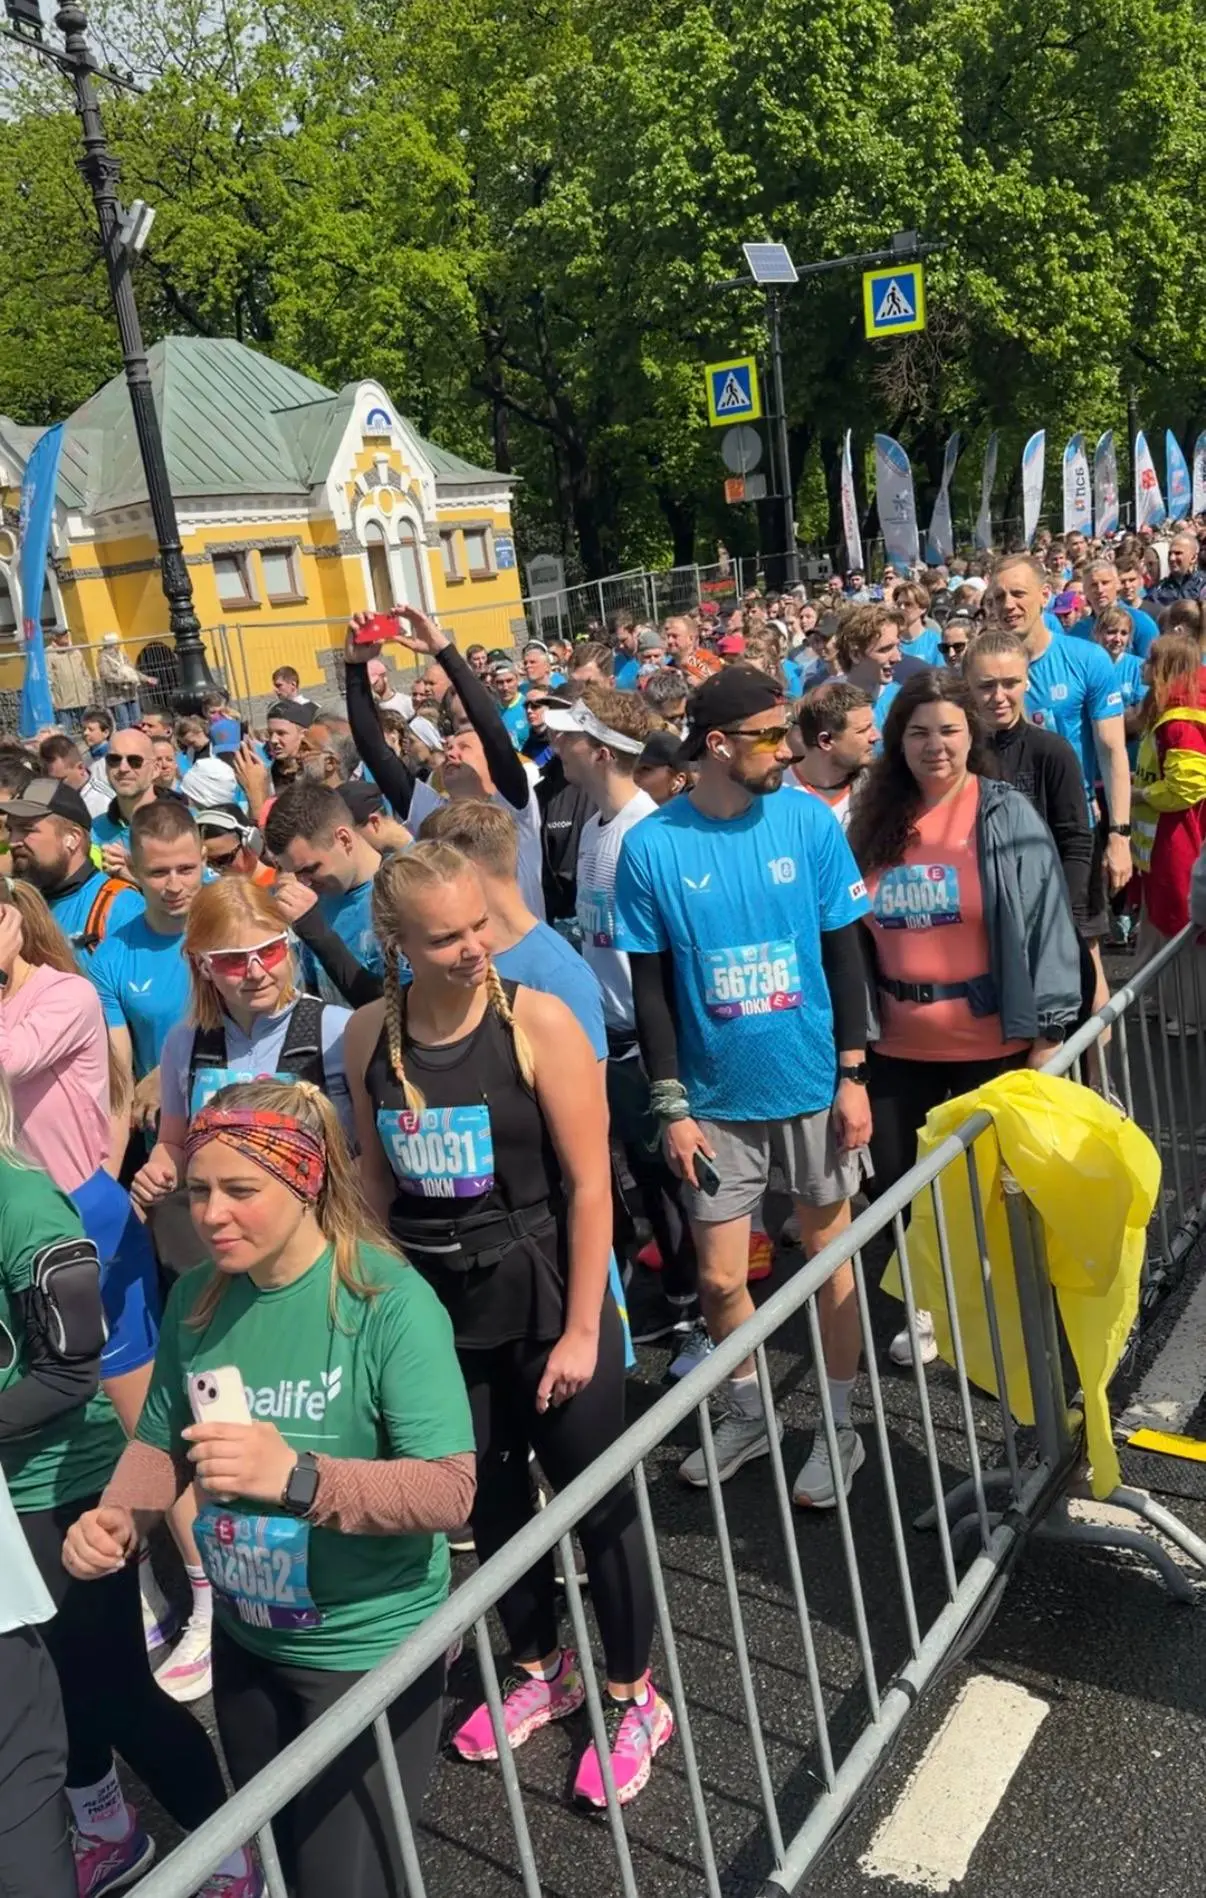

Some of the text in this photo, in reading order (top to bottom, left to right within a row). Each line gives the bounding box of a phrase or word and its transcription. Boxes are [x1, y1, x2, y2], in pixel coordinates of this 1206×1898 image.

[1074, 466, 1086, 498] ПСБ
[767, 856, 796, 885] 10
[905, 913, 932, 929] 10KM
[713, 958, 789, 1001] 56736
[739, 996, 772, 1017] 10KM
[773, 994, 785, 1007] E
[391, 1130, 477, 1176] 50031
[420, 1177, 456, 1198] 10KM
[236, 1597, 273, 1629] 10KM
